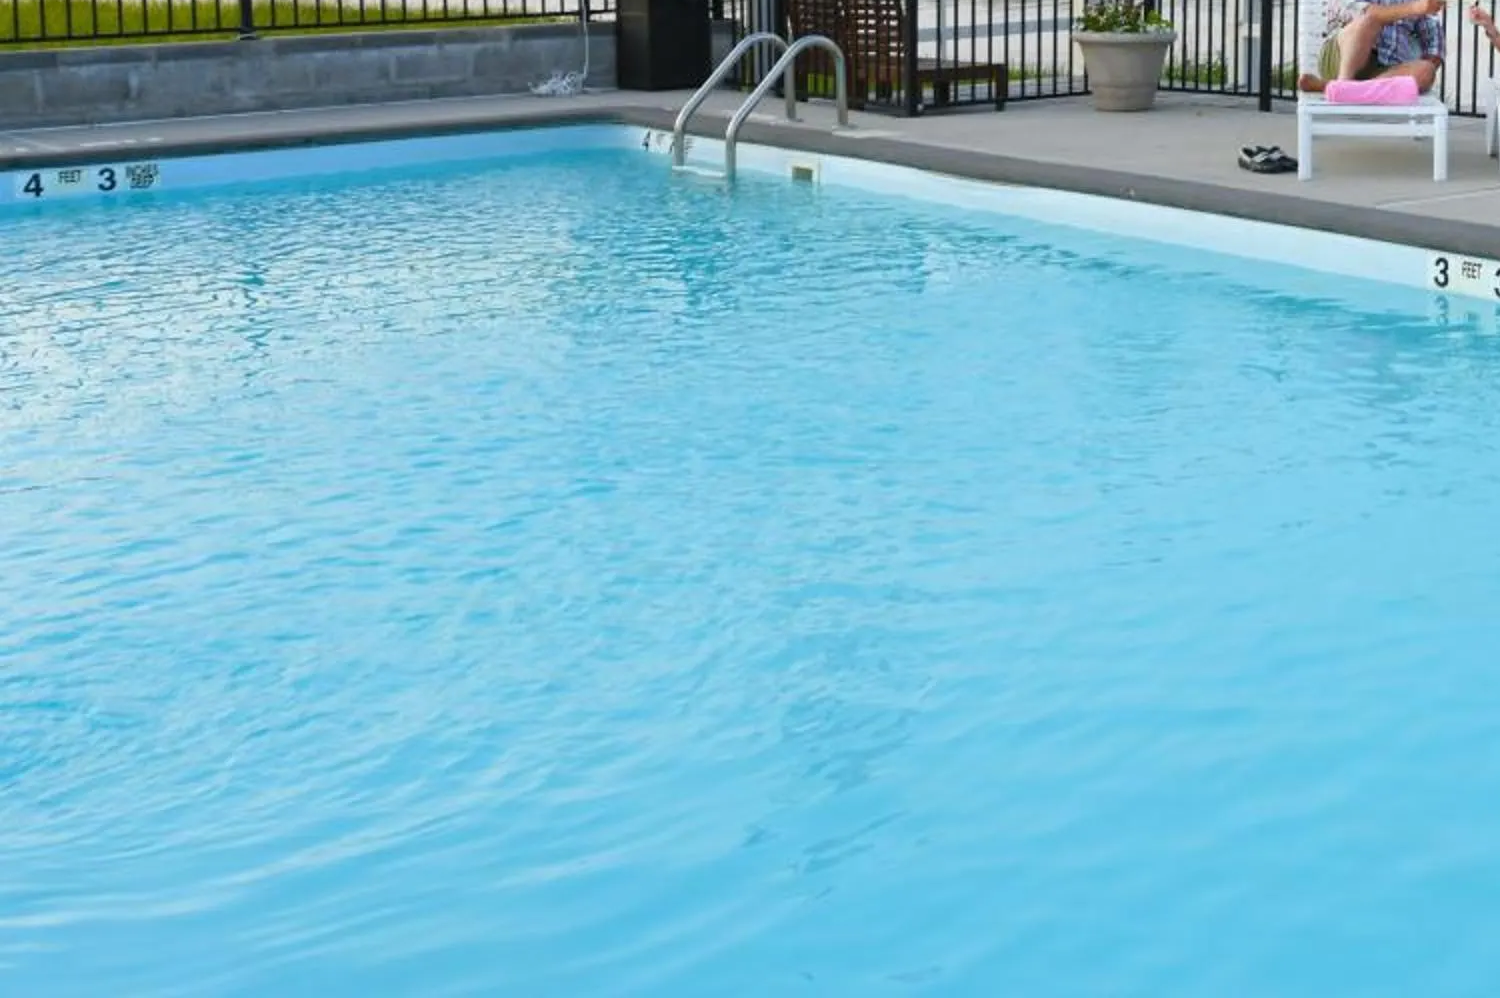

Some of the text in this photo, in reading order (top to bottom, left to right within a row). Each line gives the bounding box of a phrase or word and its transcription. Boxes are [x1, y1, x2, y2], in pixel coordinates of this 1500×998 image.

[23, 173, 44, 197] 4
[58, 169, 81, 184] FEET
[98, 168, 117, 191] 3
[1434, 257, 1449, 288] 3
[1462, 261, 1482, 280] FEET
